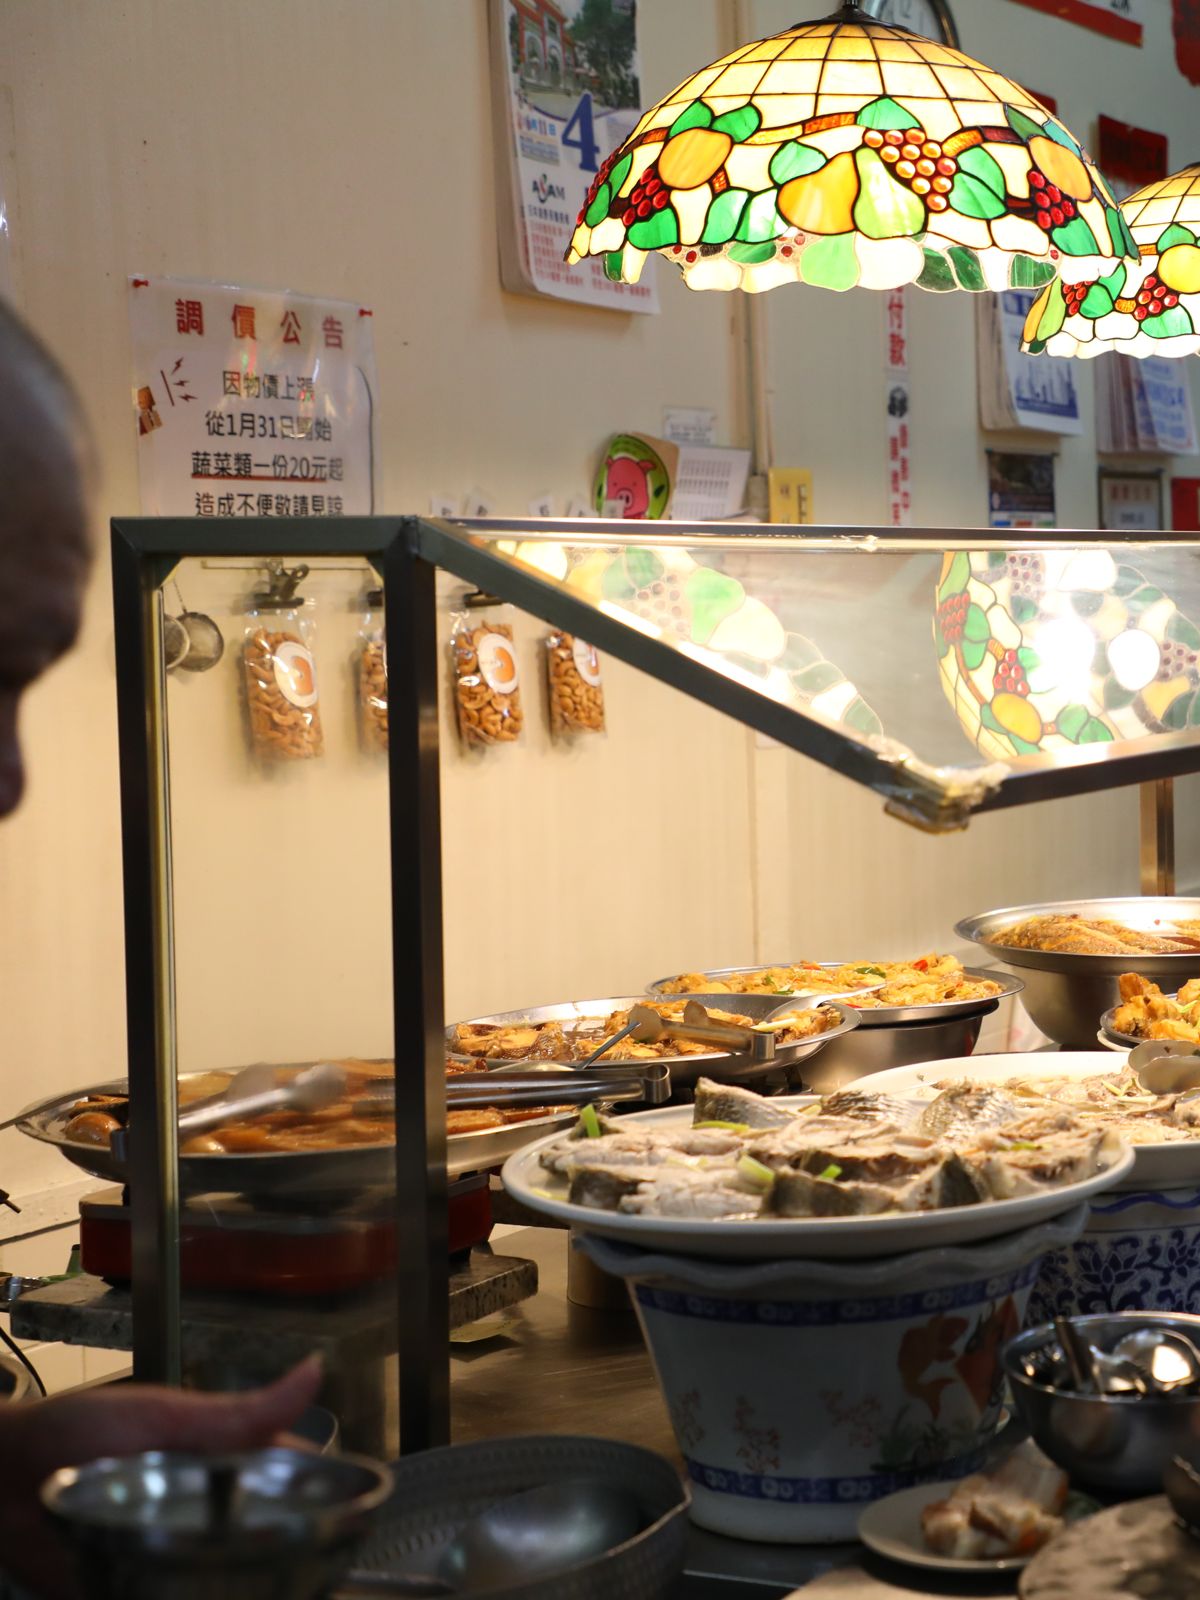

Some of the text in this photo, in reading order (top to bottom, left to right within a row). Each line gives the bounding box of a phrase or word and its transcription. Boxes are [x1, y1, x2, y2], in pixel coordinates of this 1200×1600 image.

[561, 93, 600, 173] 4
[175, 299, 344, 350] 調價公告
[191, 452, 344, 482] 蔬菜類一份20元起
